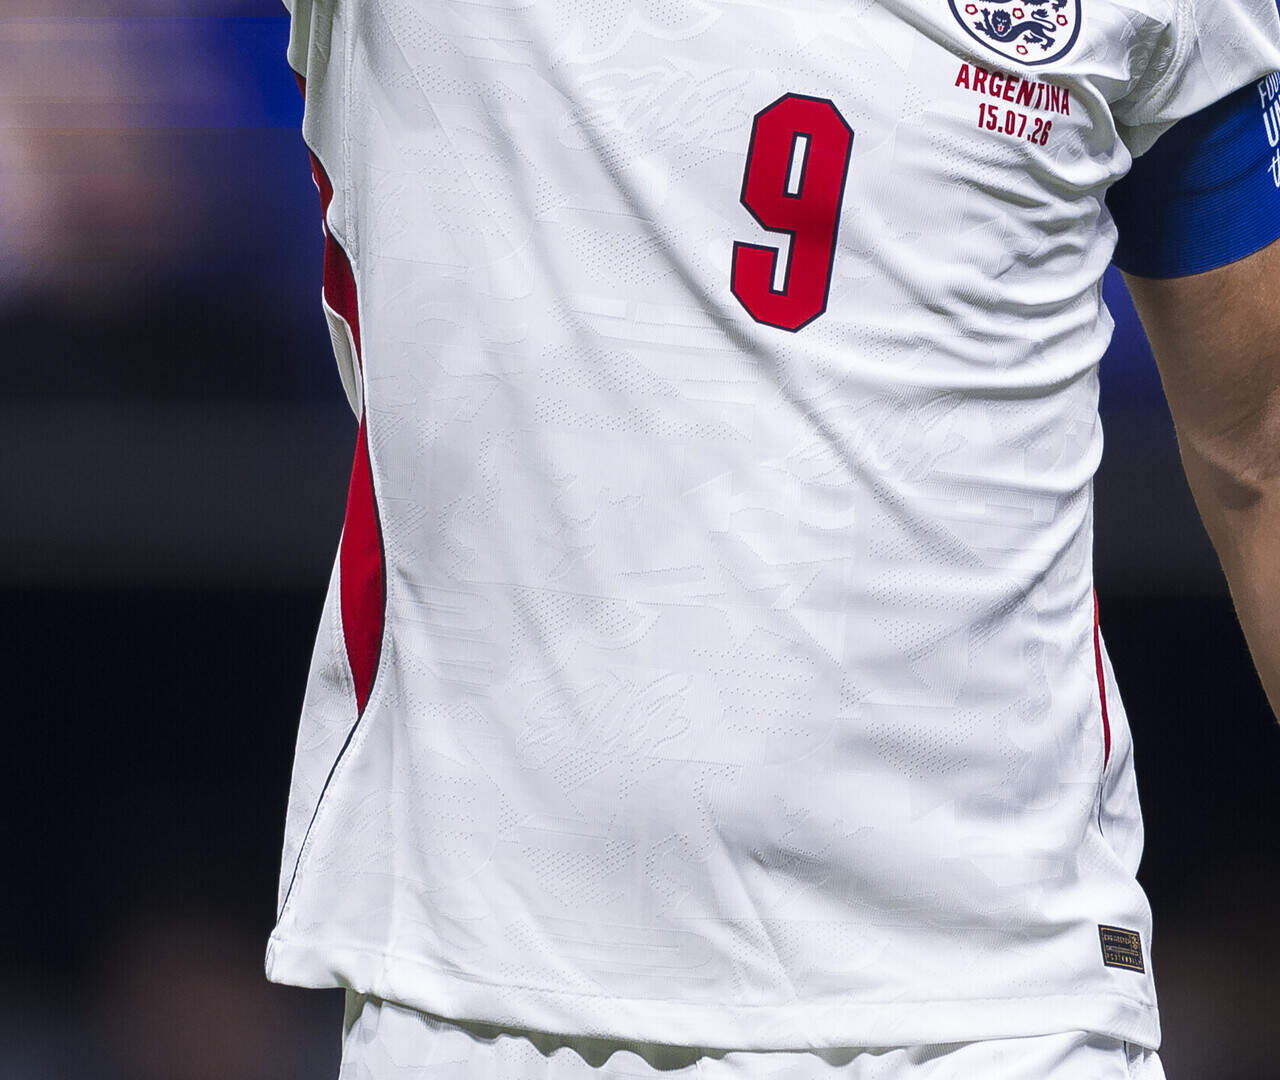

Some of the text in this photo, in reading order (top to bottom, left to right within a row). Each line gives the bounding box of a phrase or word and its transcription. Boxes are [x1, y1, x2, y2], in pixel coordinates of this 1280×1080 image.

[955, 64, 1070, 115] ARGENTINA
[978, 103, 1052, 146] 15.07.26
[730, 92, 854, 333] 9
